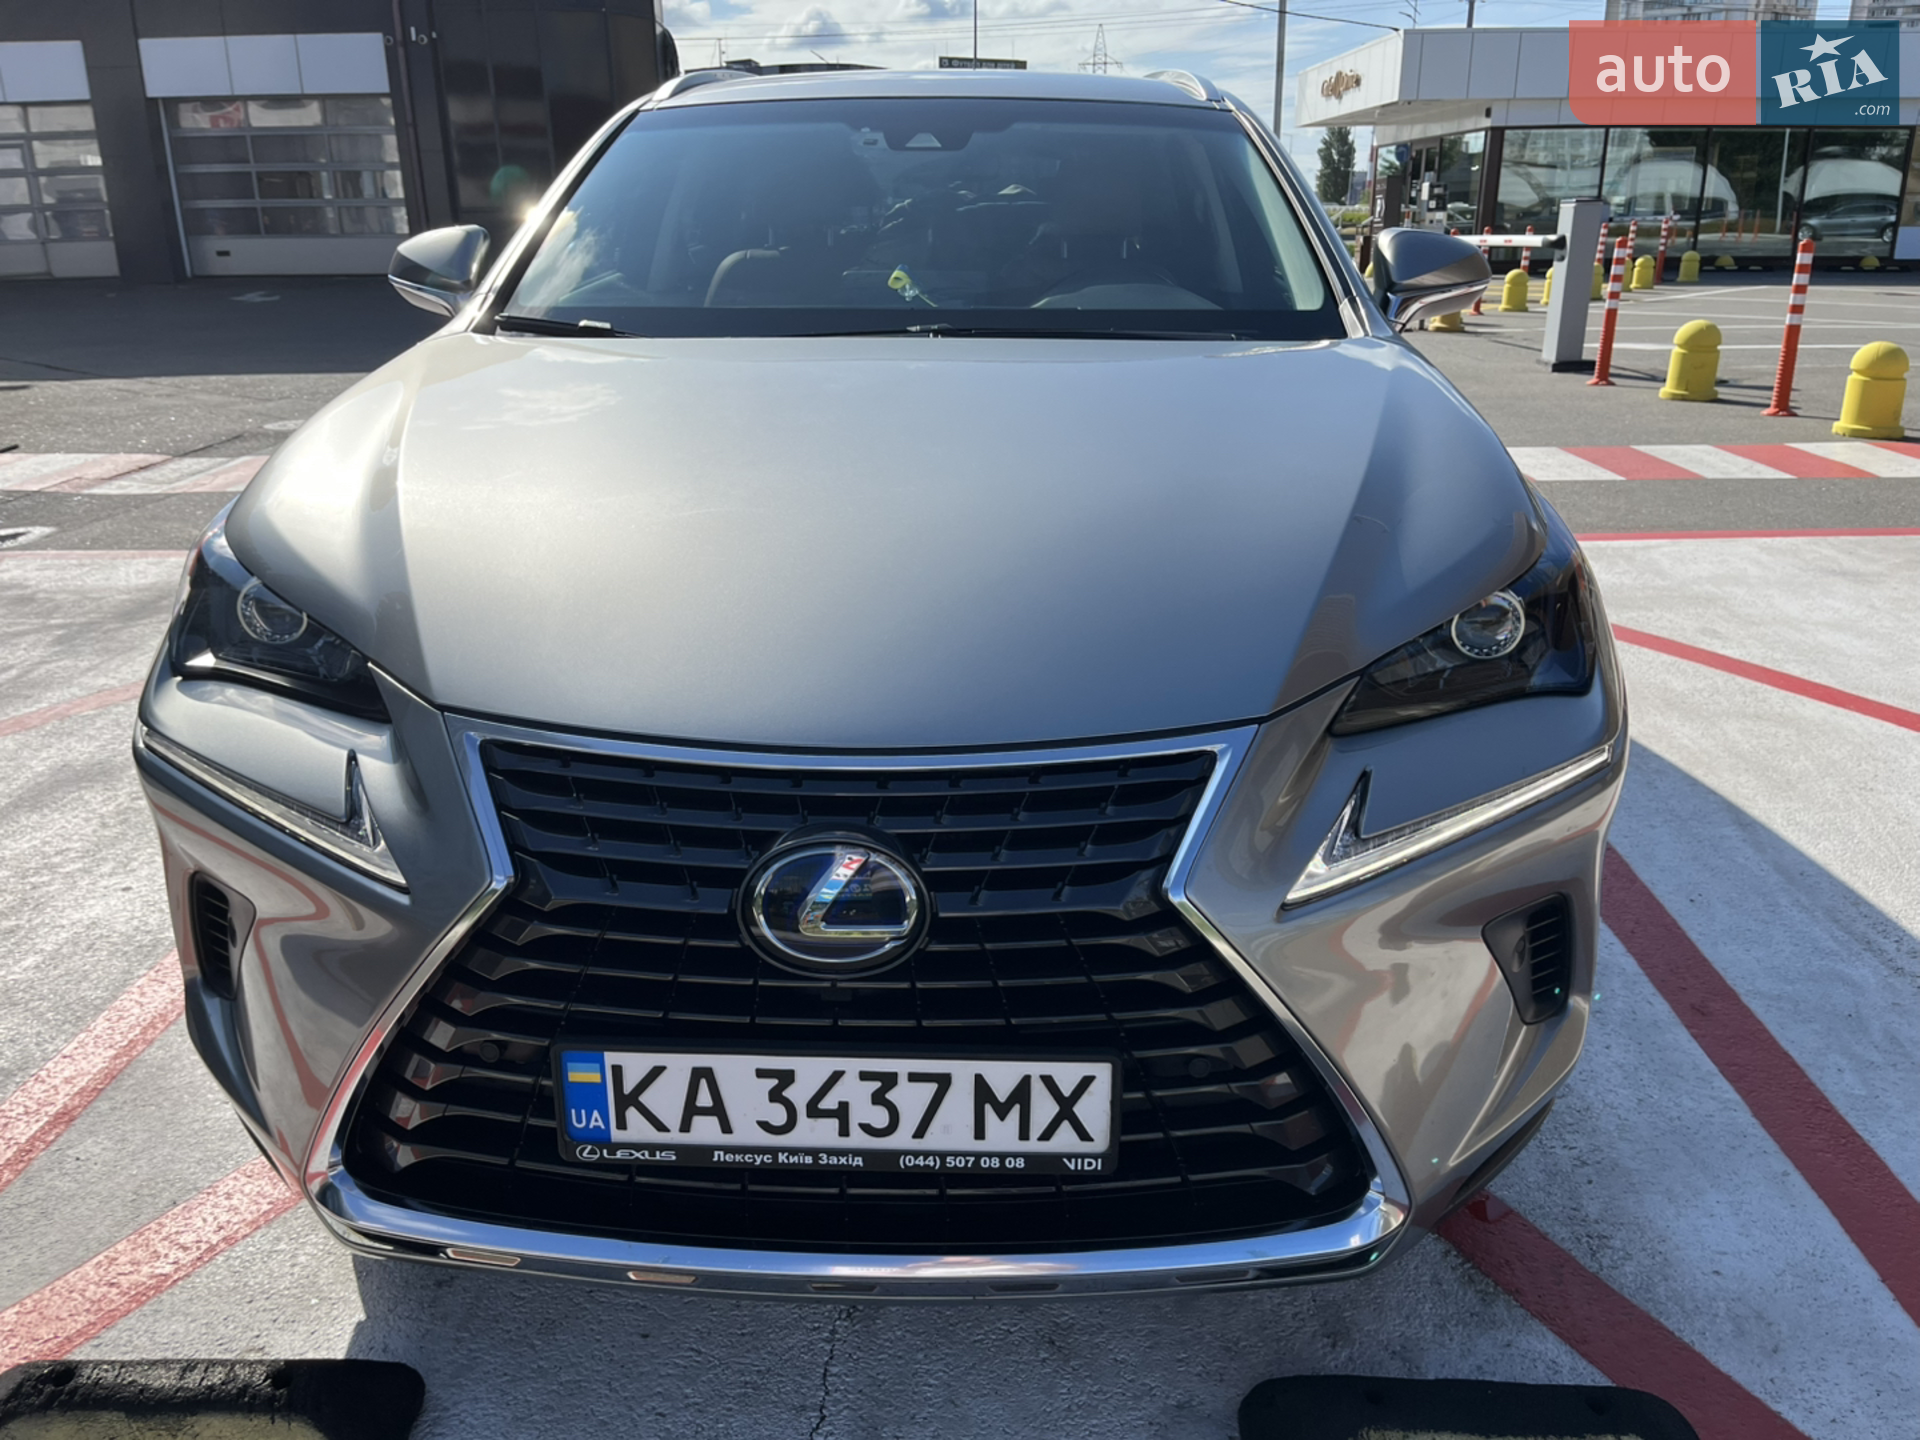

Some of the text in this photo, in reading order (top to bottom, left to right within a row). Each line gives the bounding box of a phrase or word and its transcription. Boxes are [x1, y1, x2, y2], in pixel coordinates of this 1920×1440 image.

[611, 1064, 1096, 1142] KA 3437 MX
[571, 1108, 605, 1129] UA
[603, 1149, 677, 1161] LEXUS
[712, 1150, 863, 1167] Лексус Київ Захід
[899, 1155, 1025, 1169] (044) 507 08 08
[1062, 1158, 1102, 1170] VIDI
